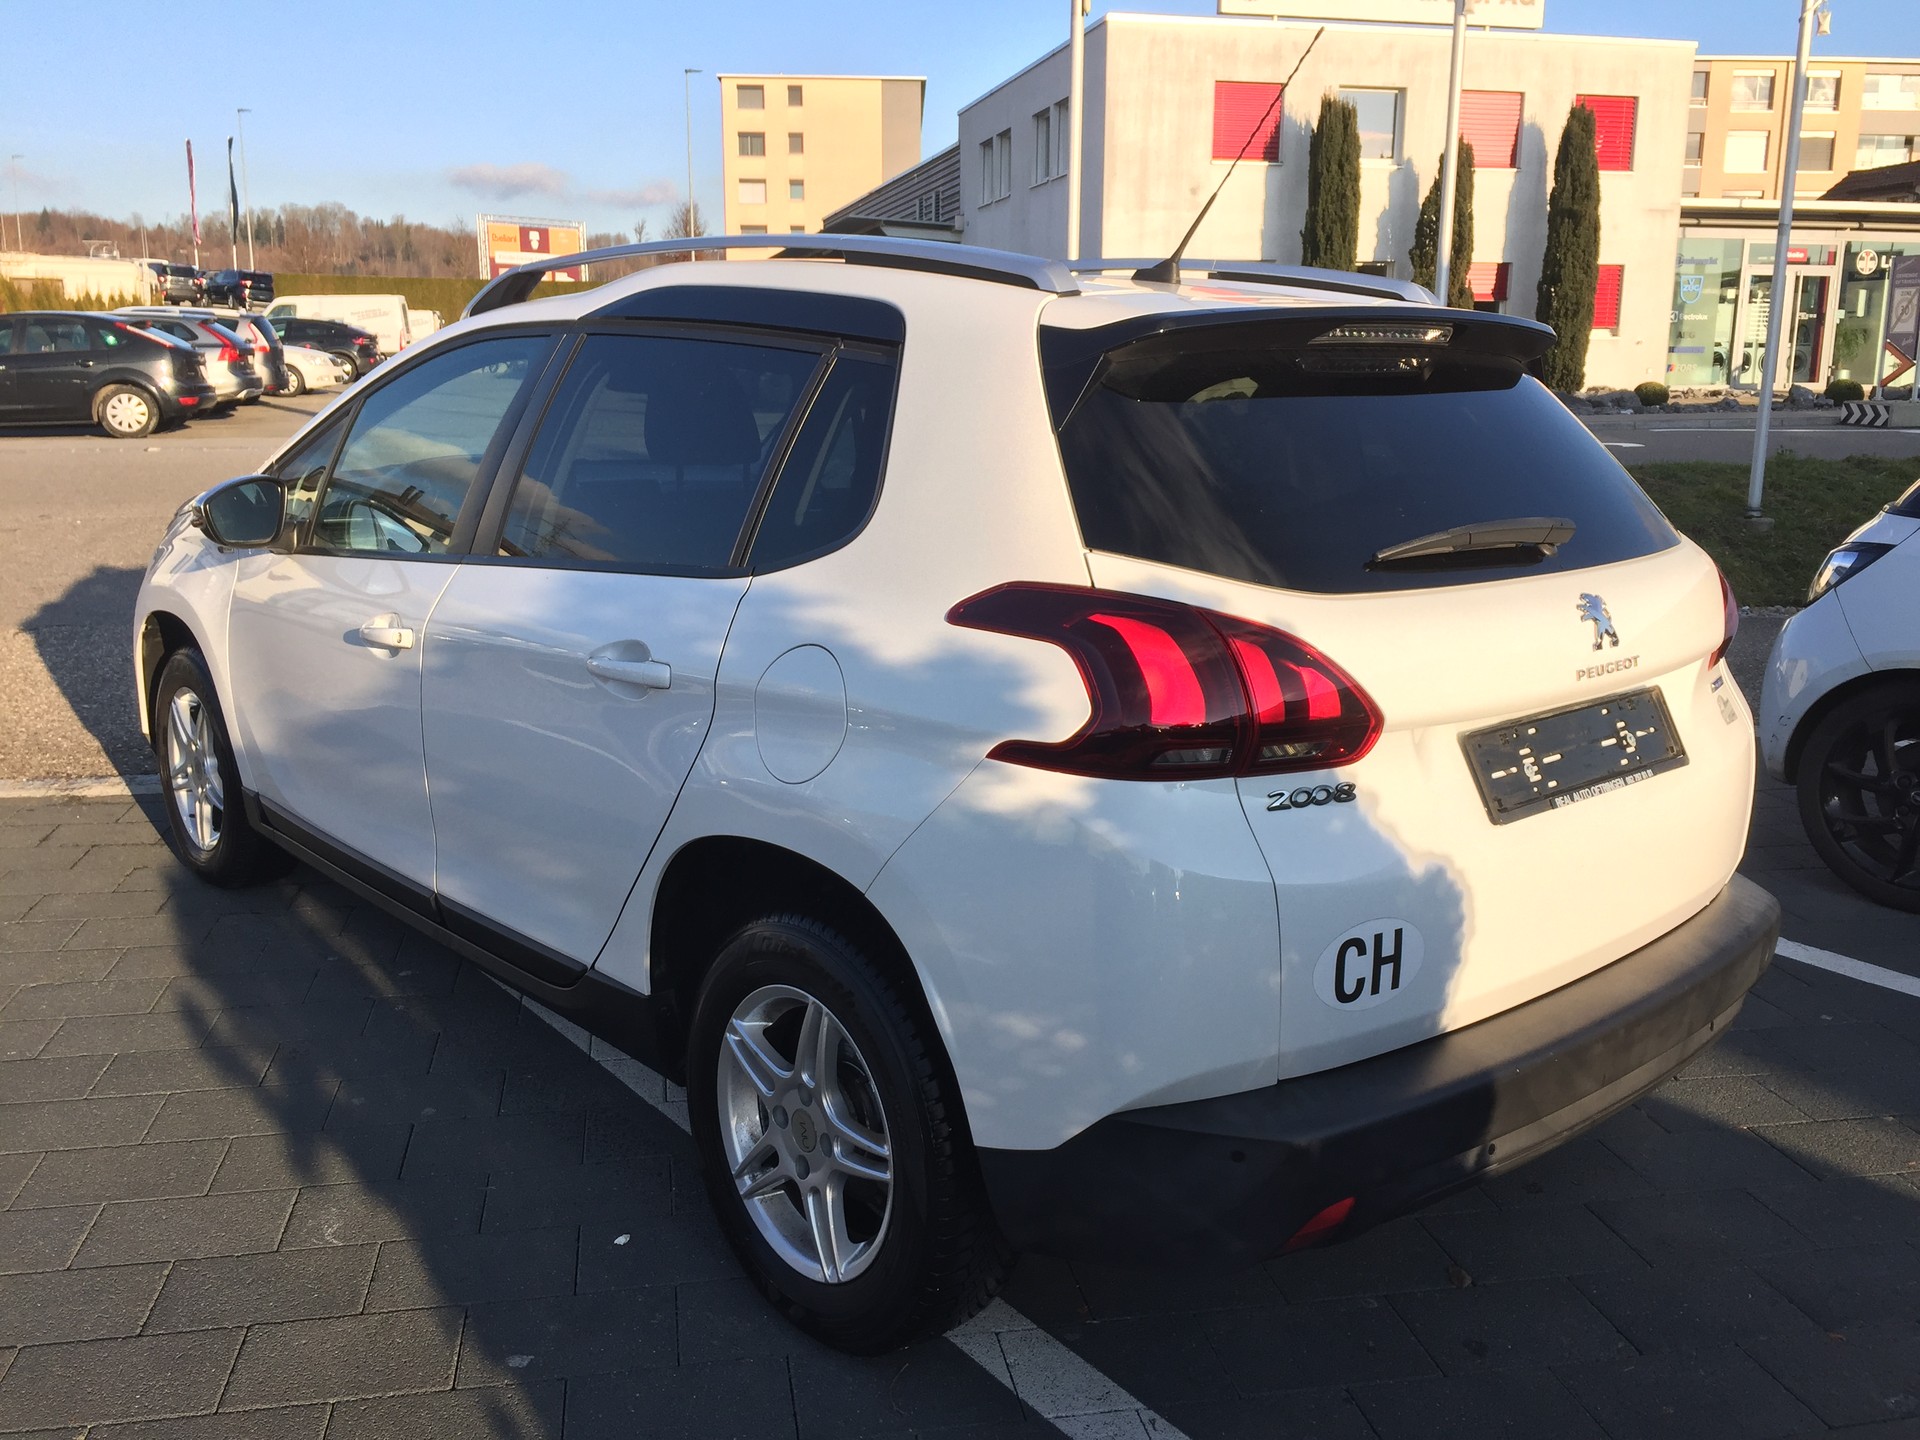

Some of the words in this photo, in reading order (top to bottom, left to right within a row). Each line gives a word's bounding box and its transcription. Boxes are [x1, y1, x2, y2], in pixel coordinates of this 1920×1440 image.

[1900, 305, 1910, 316] 30
[1576, 655, 1640, 681] PEUGEOT
[1267, 782, 1356, 811] 2008
[1555, 795, 1573, 808] REAL
[1573, 788, 1591, 803] AUTO
[1591, 778, 1625, 797] OFTRINGEN
[1334, 928, 1403, 1004] CH
